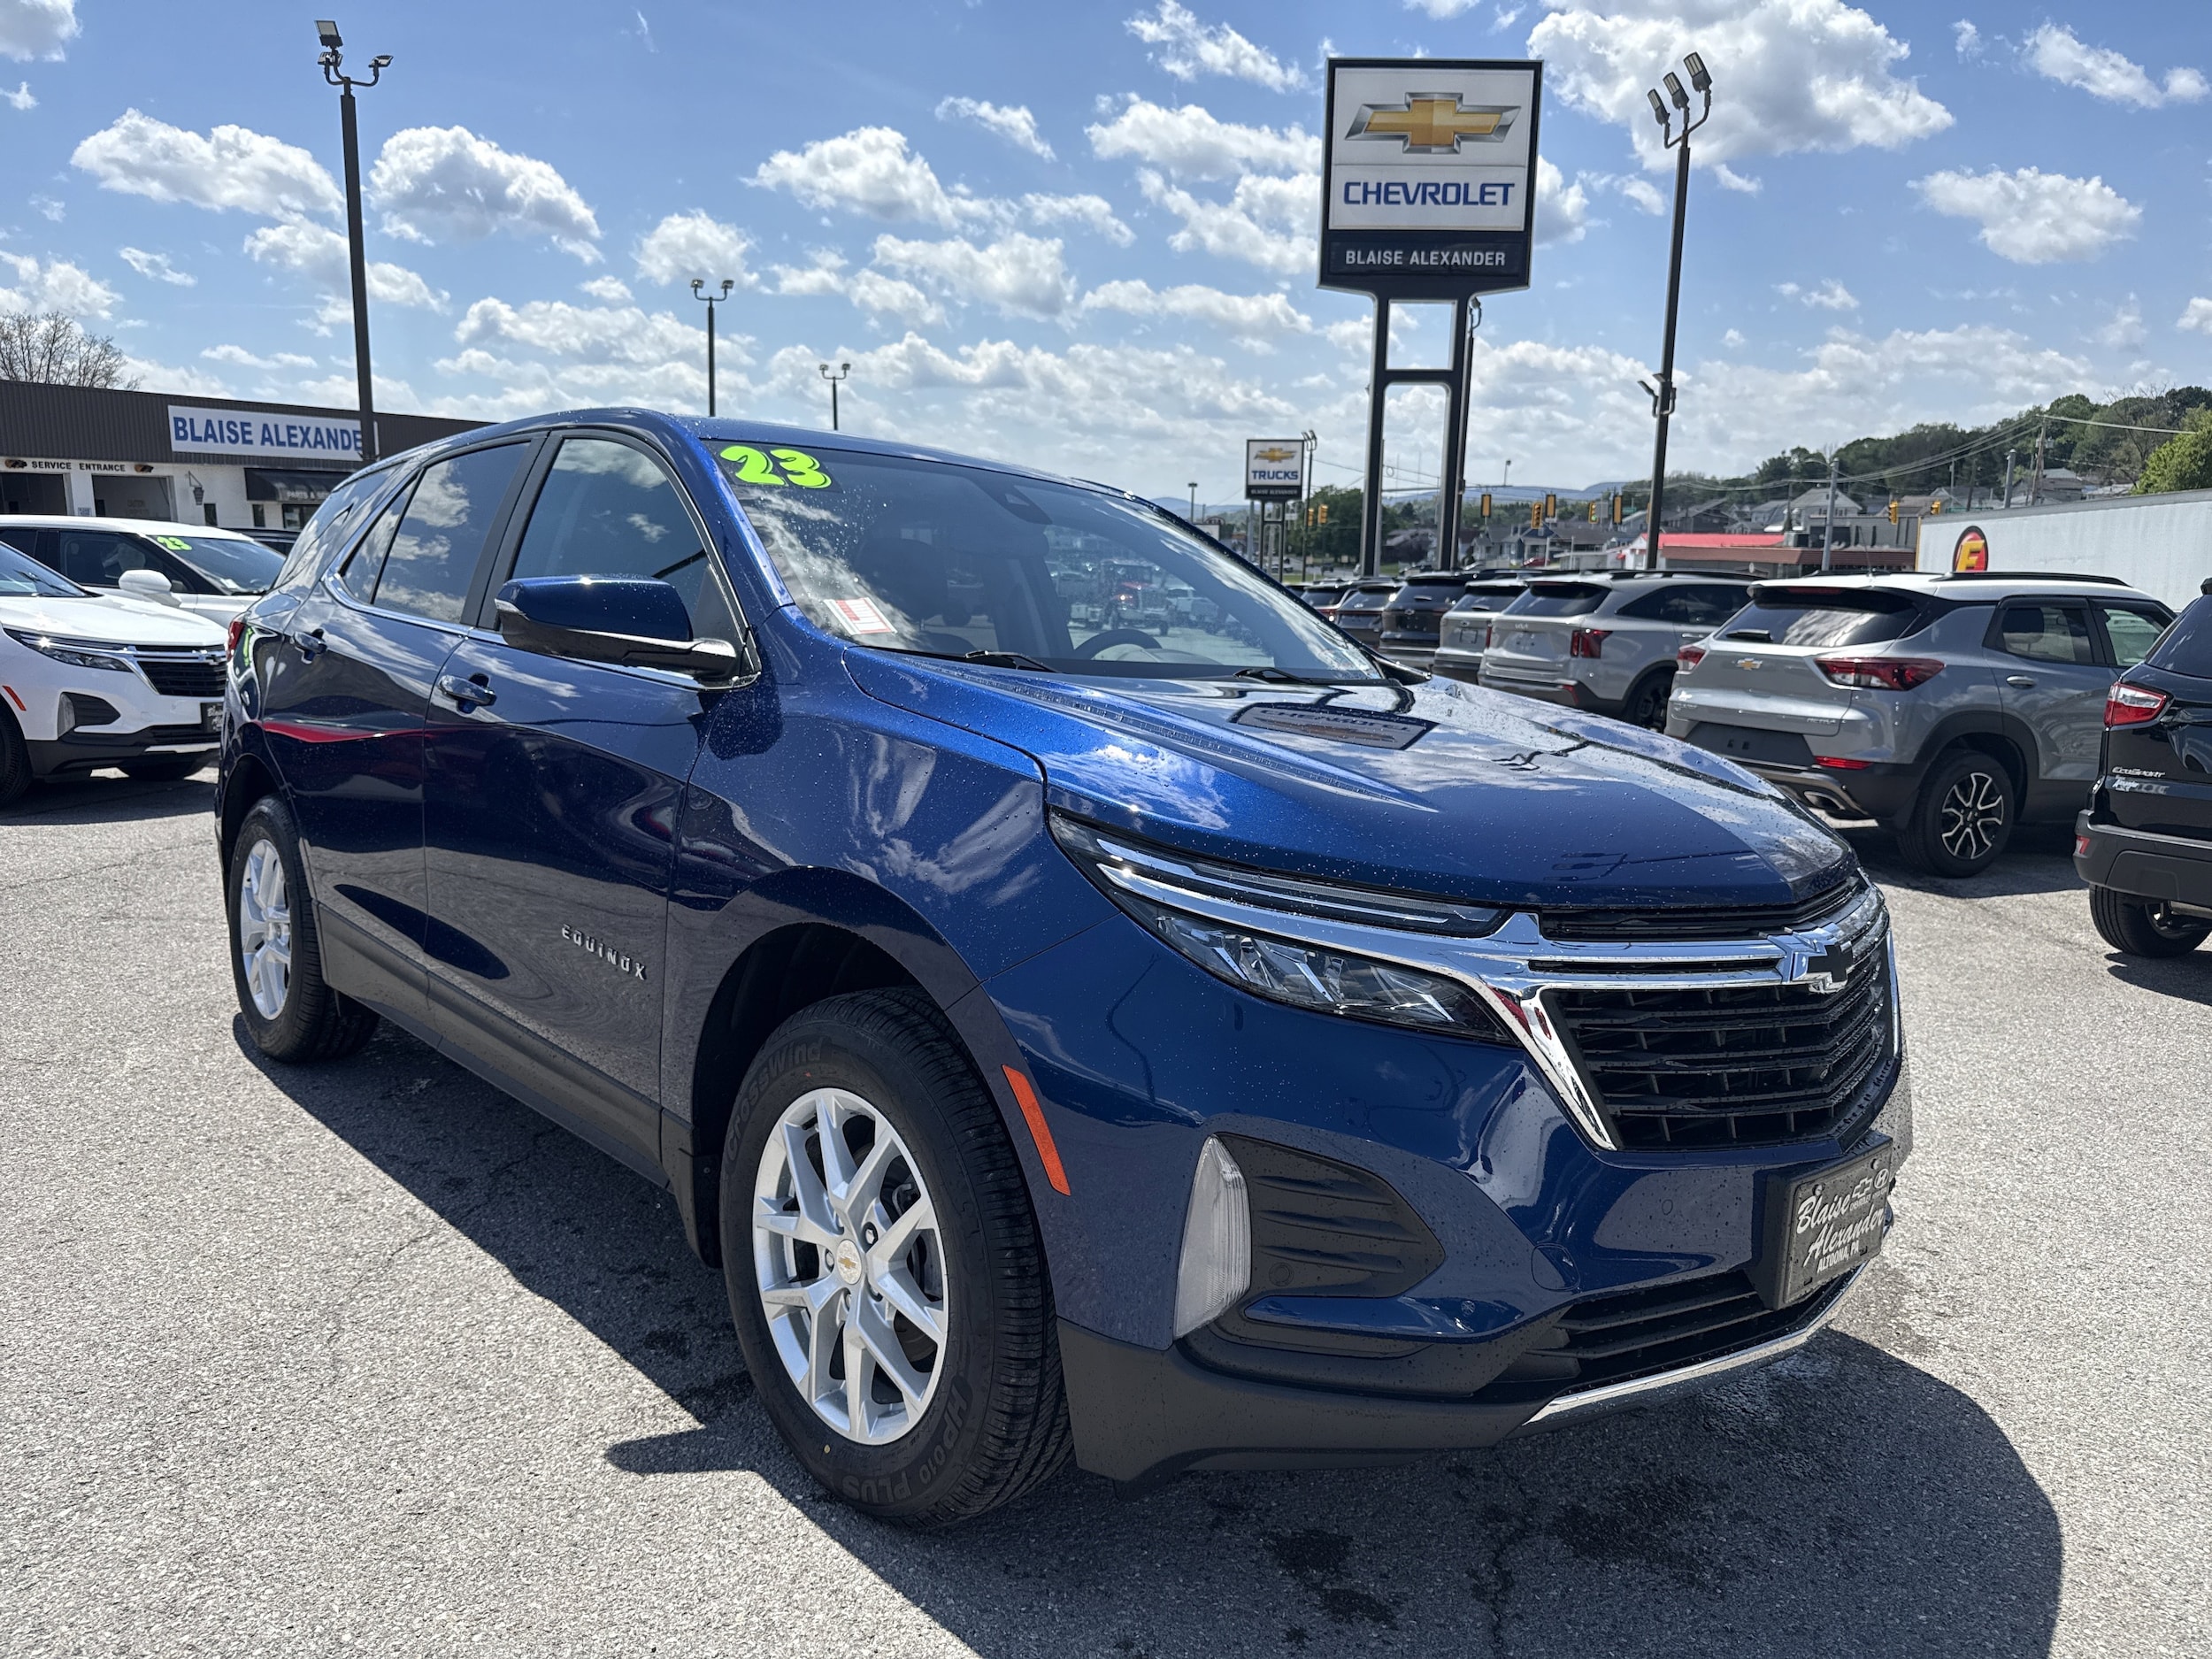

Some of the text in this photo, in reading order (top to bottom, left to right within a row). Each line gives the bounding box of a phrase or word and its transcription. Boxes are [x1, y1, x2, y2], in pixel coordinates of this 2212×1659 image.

[1343, 181, 1515, 206] CHEVROLET
[1345, 250, 1506, 266] BLAISE ALEXANDER
[173, 416, 363, 451] BLAISE ALEXANDE
[31, 461, 126, 472] SERVICE ENTRANCE
[720, 445, 832, 488] 23
[1251, 470, 1299, 480] TRUCKS
[157, 536, 193, 550] 23
[561, 924, 646, 981] EQUINOX
[1796, 1194, 1851, 1234] Blaise
[1803, 1204, 1885, 1268] Alexander
[1850, 1240, 1860, 1256] PA
[841, 1469, 912, 1503] PLUS
